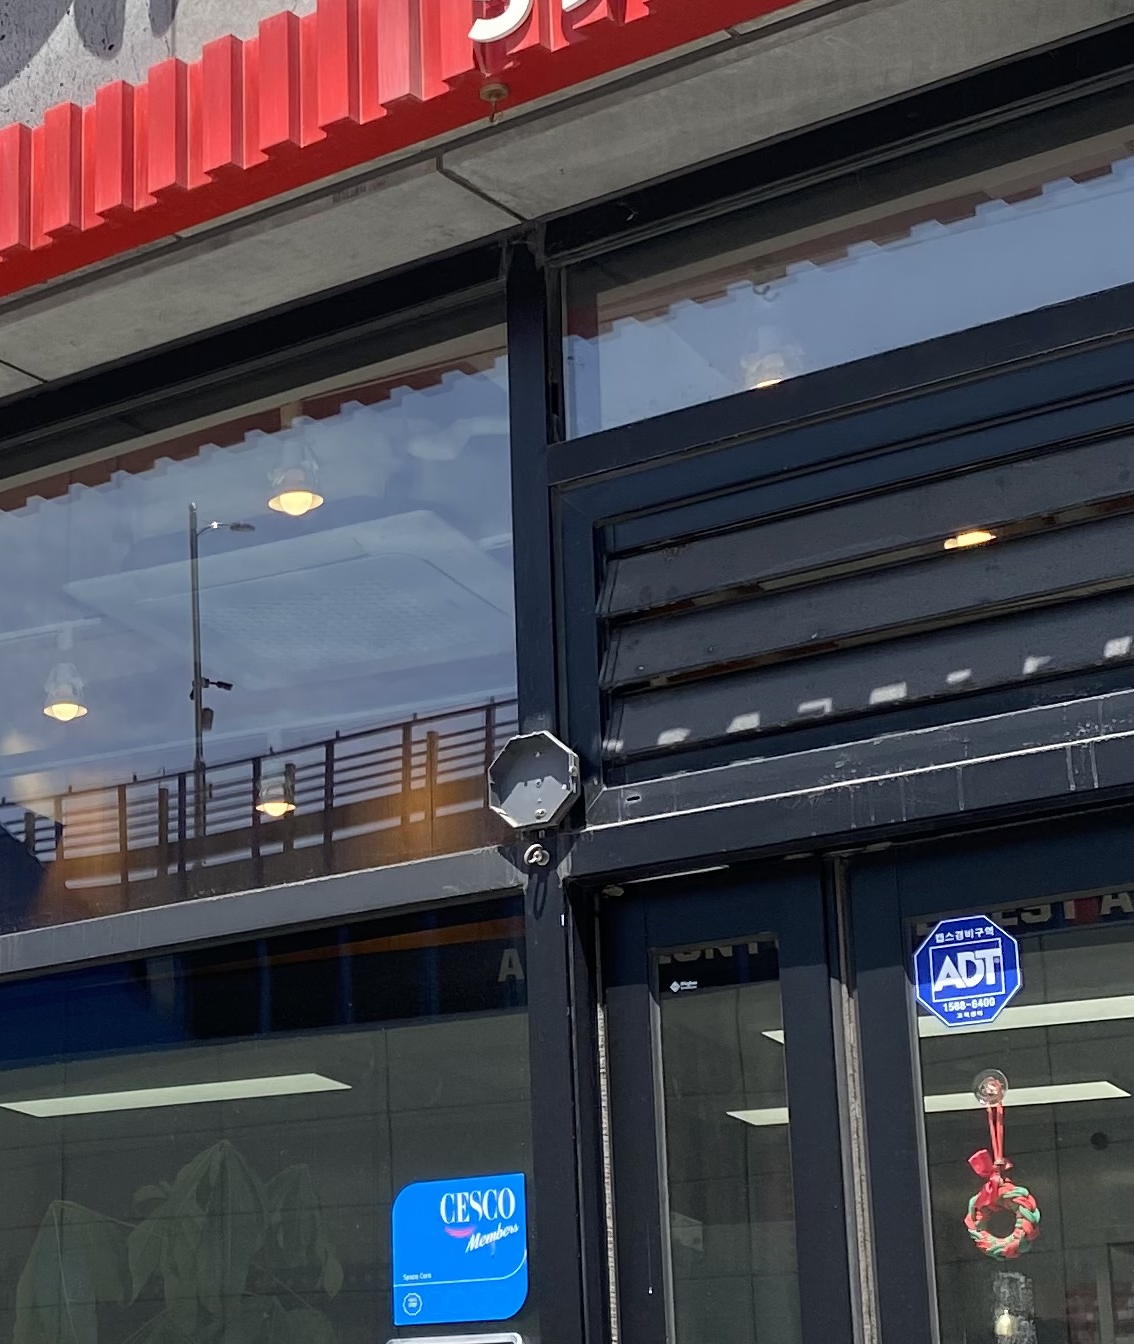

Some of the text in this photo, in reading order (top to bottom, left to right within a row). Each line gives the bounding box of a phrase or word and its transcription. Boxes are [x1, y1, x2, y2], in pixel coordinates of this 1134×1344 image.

[934, 947, 1001, 992] ADT
[440, 1187, 516, 1224] CESCO
[465, 1222, 520, 1253] Members
